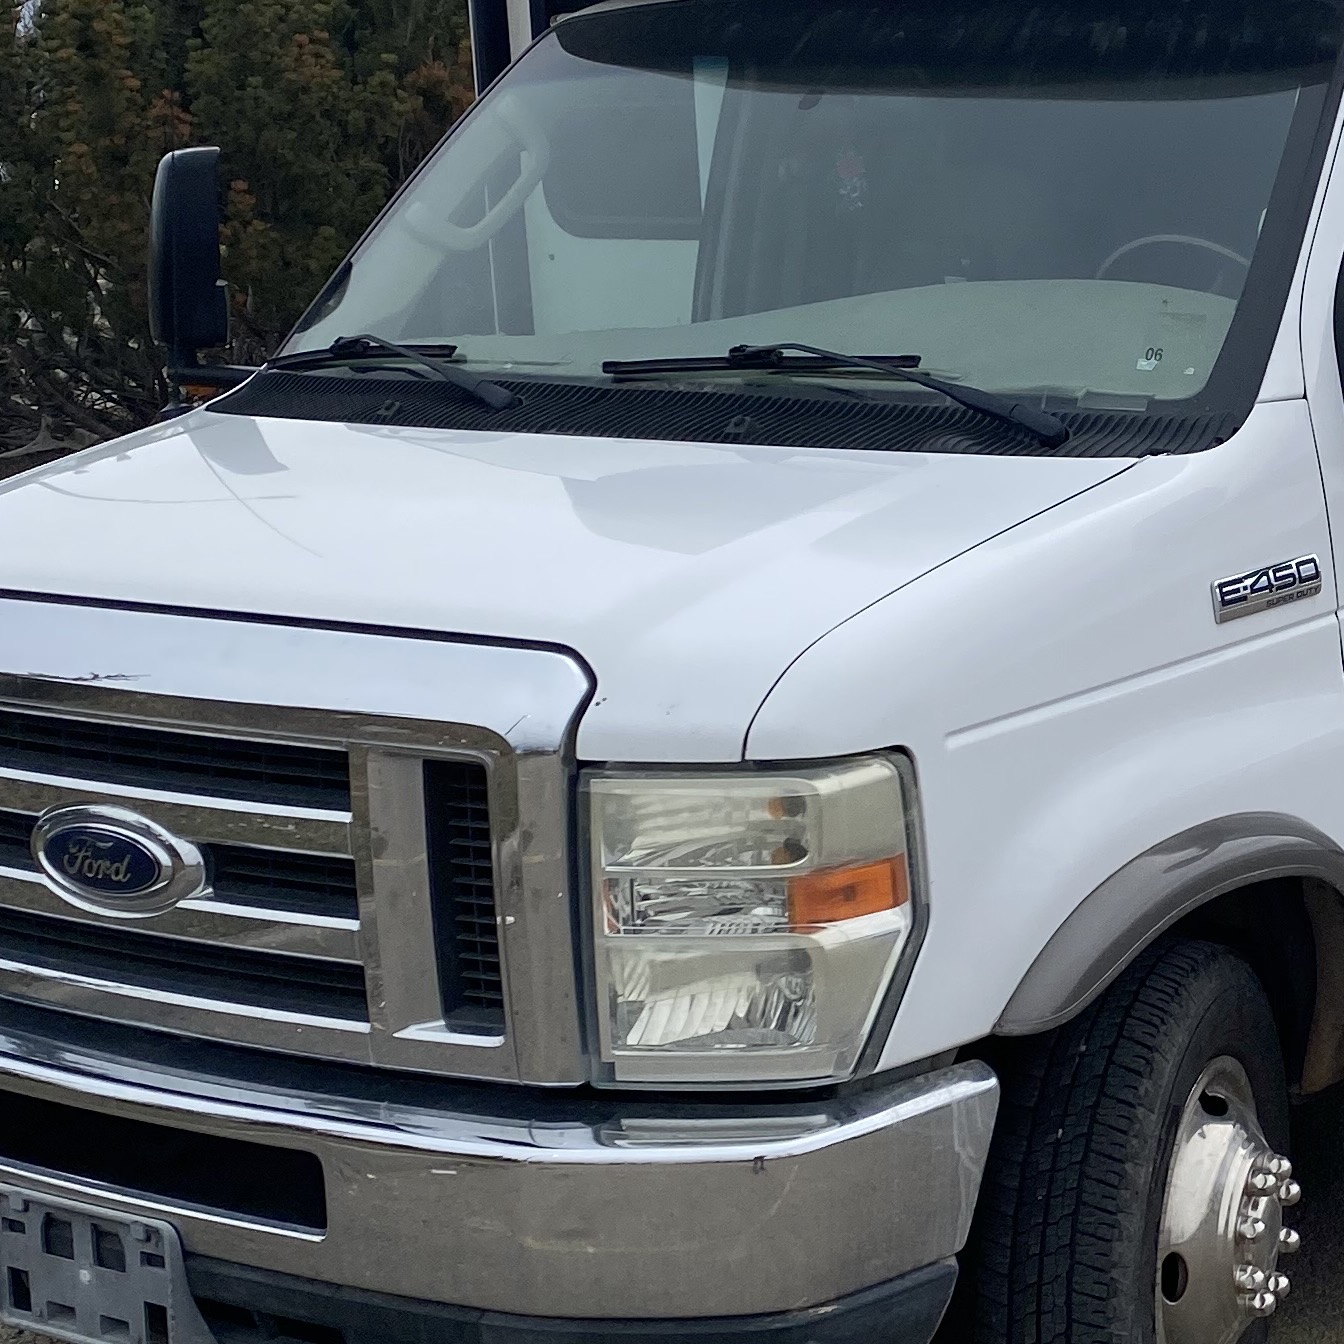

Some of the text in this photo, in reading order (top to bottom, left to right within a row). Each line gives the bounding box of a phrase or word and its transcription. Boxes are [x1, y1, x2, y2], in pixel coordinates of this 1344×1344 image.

[1145, 347, 1164, 362] 06
[1266, 586, 1321, 607] SUPER DUTY
[63, 836, 132, 883] Ford
